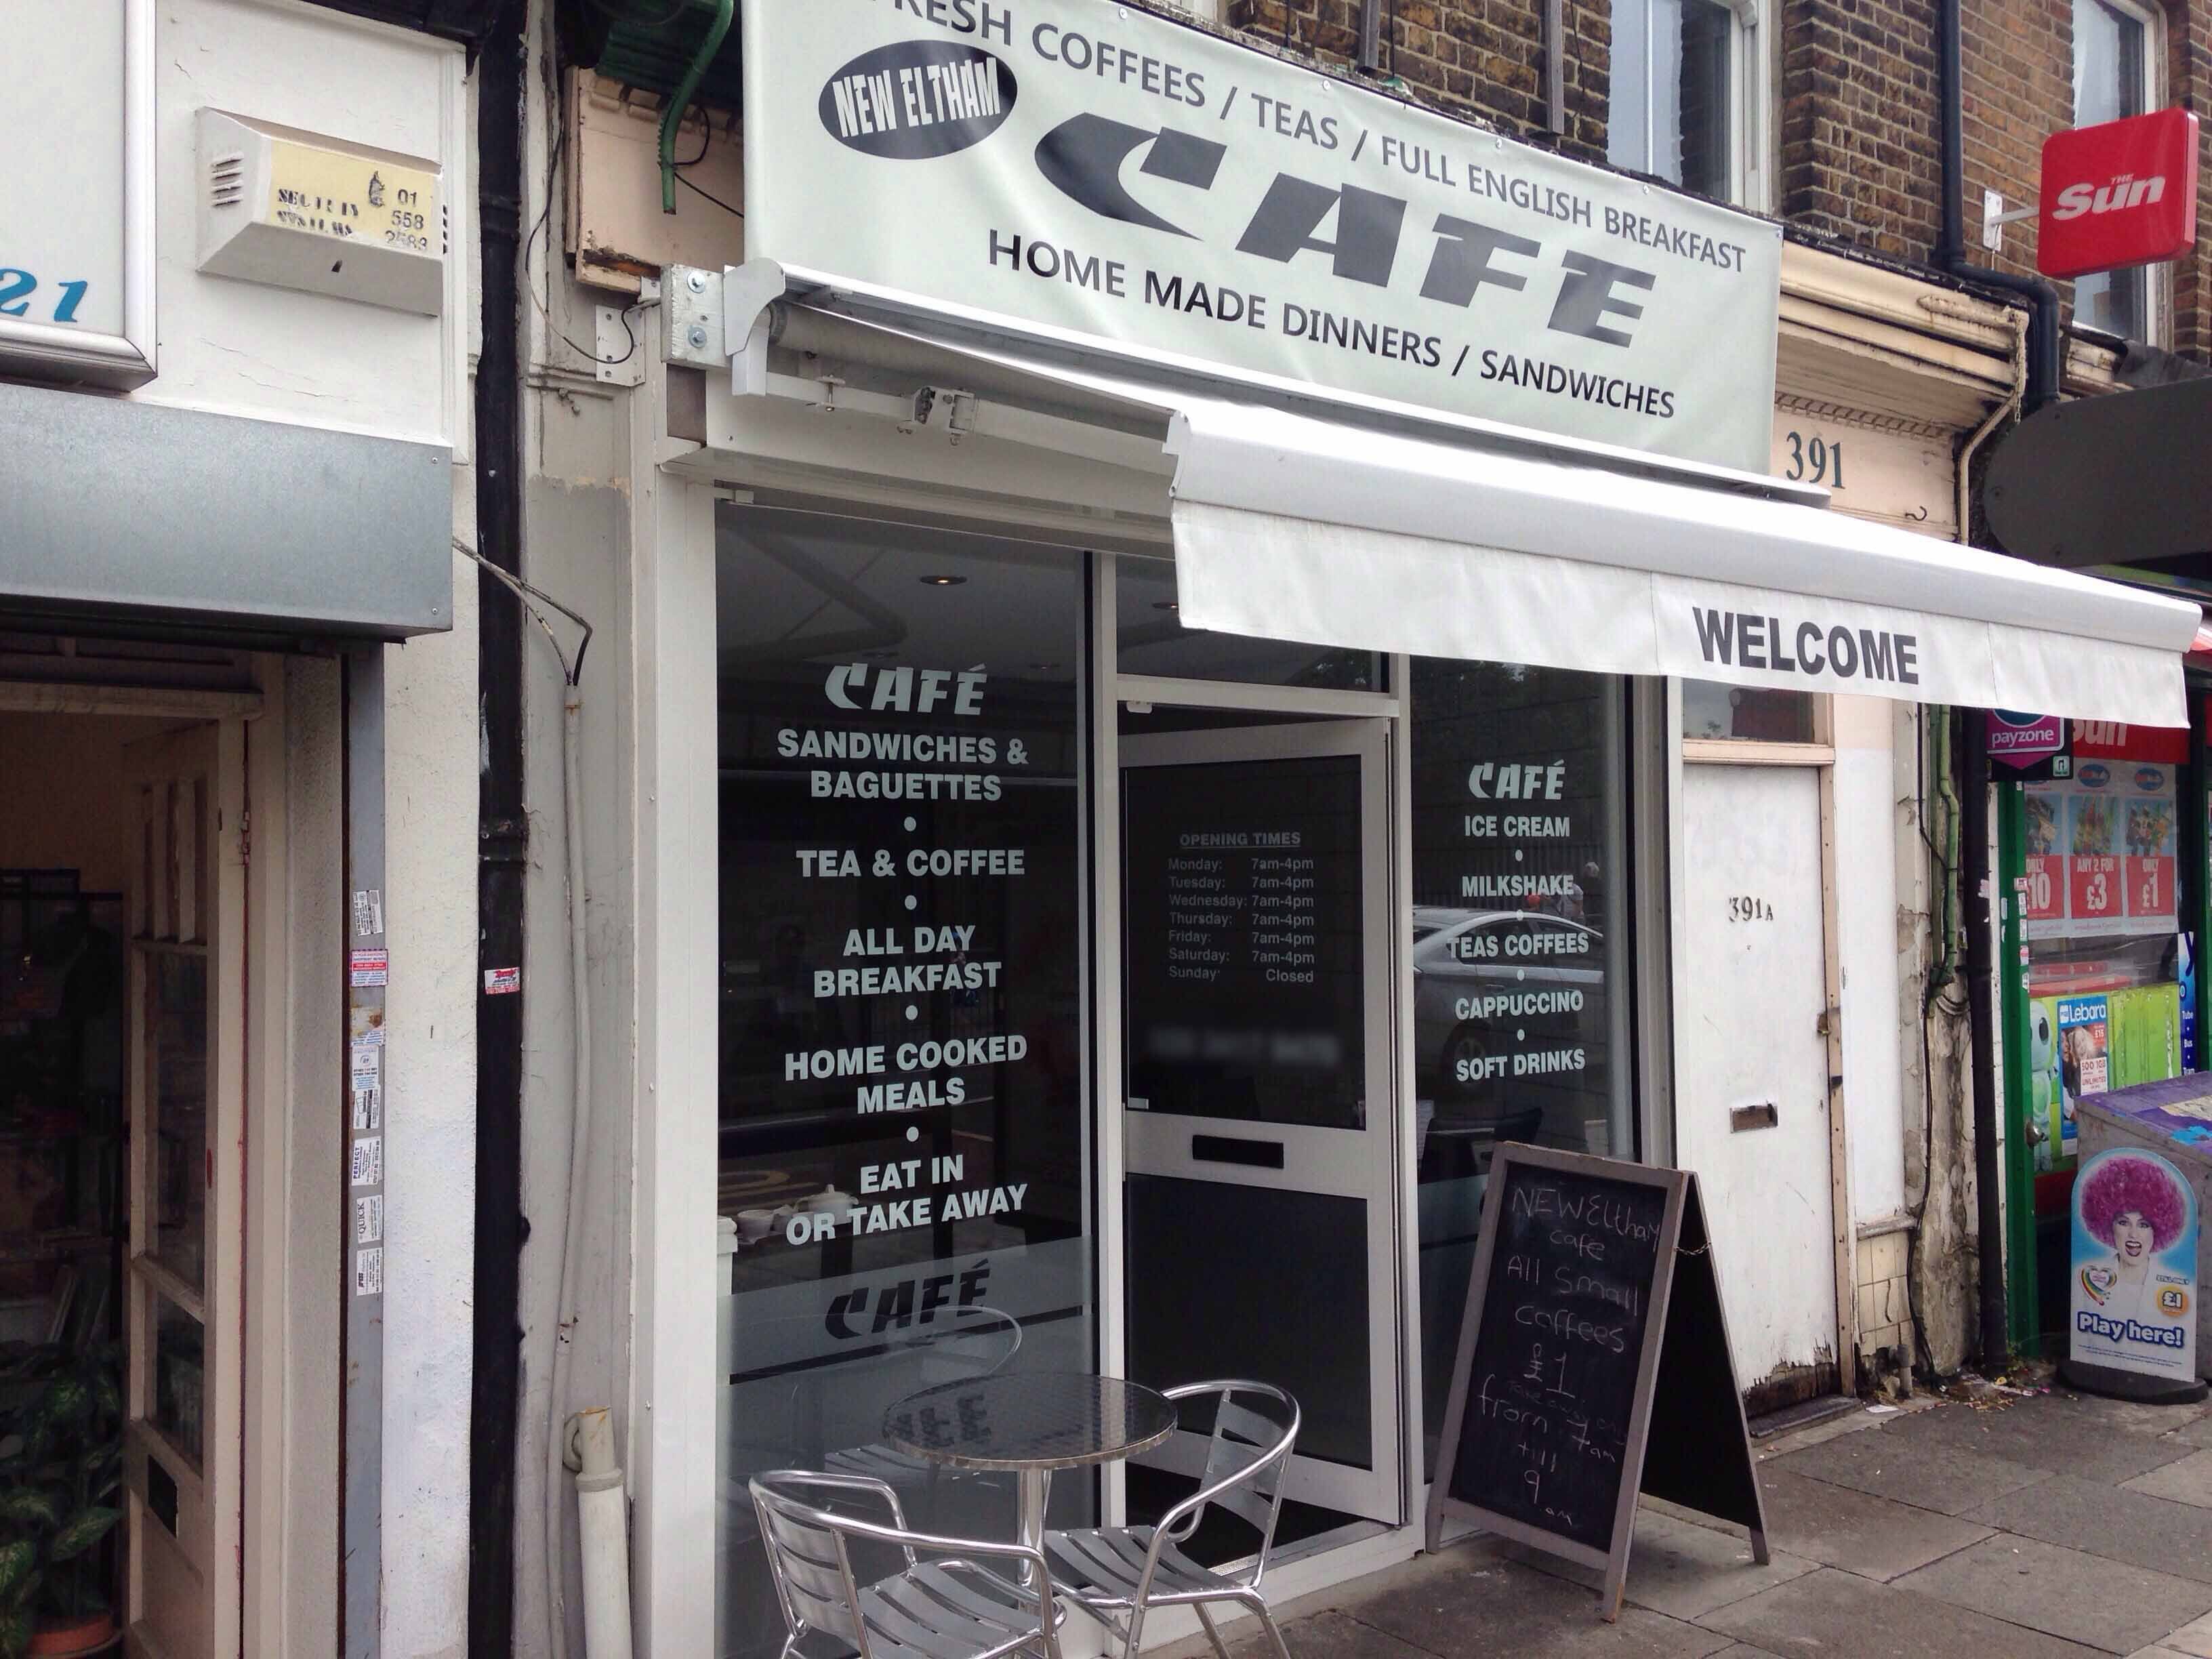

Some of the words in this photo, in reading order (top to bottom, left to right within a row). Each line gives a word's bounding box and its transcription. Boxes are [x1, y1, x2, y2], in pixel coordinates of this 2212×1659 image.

[832, 70, 897, 138] NEW
[900, 57, 1001, 129] ELTHAM
[893, 0, 1011, 46] ESH
[1032, 23, 1206, 107] COFFEES
[1251, 93, 1338, 150] TEAS
[1381, 137, 1456, 186] FULL
[1469, 164, 1592, 228] ENGLISH
[1604, 205, 1746, 272] BREAKFAST
[2110, 173, 2134, 184] THE
[397, 188, 418, 205] 01
[2052, 175, 2167, 222] Sun
[391, 210, 425, 230] 558
[1034, 112, 1657, 348] CAFE
[989, 228, 1125, 298] HOME
[1145, 270, 1266, 329] MADE
[1282, 302, 1441, 367] DINNERS
[1480, 349, 1675, 419] SANDWICHES
[1785, 430, 1846, 490] 391
[1692, 607, 1919, 684] WELCOME
[824, 663, 987, 715] CAFÉ
[777, 729, 996, 764] SANDWICHES
[1006, 738, 1029, 764] &
[1992, 729, 2054, 748] payzone
[2073, 720, 2127, 746] un
[811, 771, 1002, 801] BAGUETTES
[1469, 759, 1565, 800] CAFÉ
[1179, 833, 1248, 846] OPENING
[1253, 832, 1301, 846] TIMES
[1465, 816, 1497, 837] ICE
[1504, 816, 1570, 838] CREAM
[796, 850, 861, 878] TEA
[872, 849, 897, 878] &
[907, 849, 1025, 876] COFFEE
[1168, 857, 1223, 872] Monday:
[1252, 858, 1314, 872] 7am-4pm
[1169, 876, 1225, 891] Tuesday:
[1252, 877, 1315, 890] 7am-4pm
[1462, 875, 1574, 897] MILKSHAKE
[2027, 872, 2051, 909] 10
[2087, 874, 2108, 909] £3
[2142, 874, 2158, 908] £1
[1169, 895, 1248, 909] Wednesday:
[1252, 895, 1315, 909] 7am-4pm
[1170, 912, 1233, 926] Thursday:
[1252, 914, 1315, 928] 7am-4pm
[843, 927, 903, 956] ALL
[914, 925, 975, 954] DAY
[1168, 930, 1212, 945] Friday:
[1252, 932, 1315, 947] 7am-4pm
[1448, 935, 1498, 958] TEAS
[1505, 933, 1589, 956] COFFEES
[1169, 948, 1230, 963] Saturday:
[1252, 950, 1315, 966] 7am-4pm
[813, 962, 1002, 998] BREAKFAST
[1266, 969, 1315, 983] Closed
[1455, 989, 1584, 1020] CAPPUCCINO
[2069, 1003, 2106, 1023] Lebara
[785, 1046, 885, 1082] HOME
[896, 1035, 1027, 1071] COOKED
[1457, 1057, 1507, 1082] SOFT
[1514, 1048, 1586, 1076] DRINKS
[857, 1078, 965, 1114] MEALS
[860, 1160, 920, 1194] EAT
[933, 1155, 963, 1185] IN
[357, 1202, 367, 1235] QUICK
[785, 1212, 836, 1246] OR
[846, 1197, 932, 1237] TAKE
[941, 1184, 1028, 1221] AWAY
[825, 1258, 991, 1340] CAFÉ
[2163, 1291, 2183, 1309] £1
[2078, 1311, 2125, 1343] Play
[2127, 1319, 2184, 1348] here!
